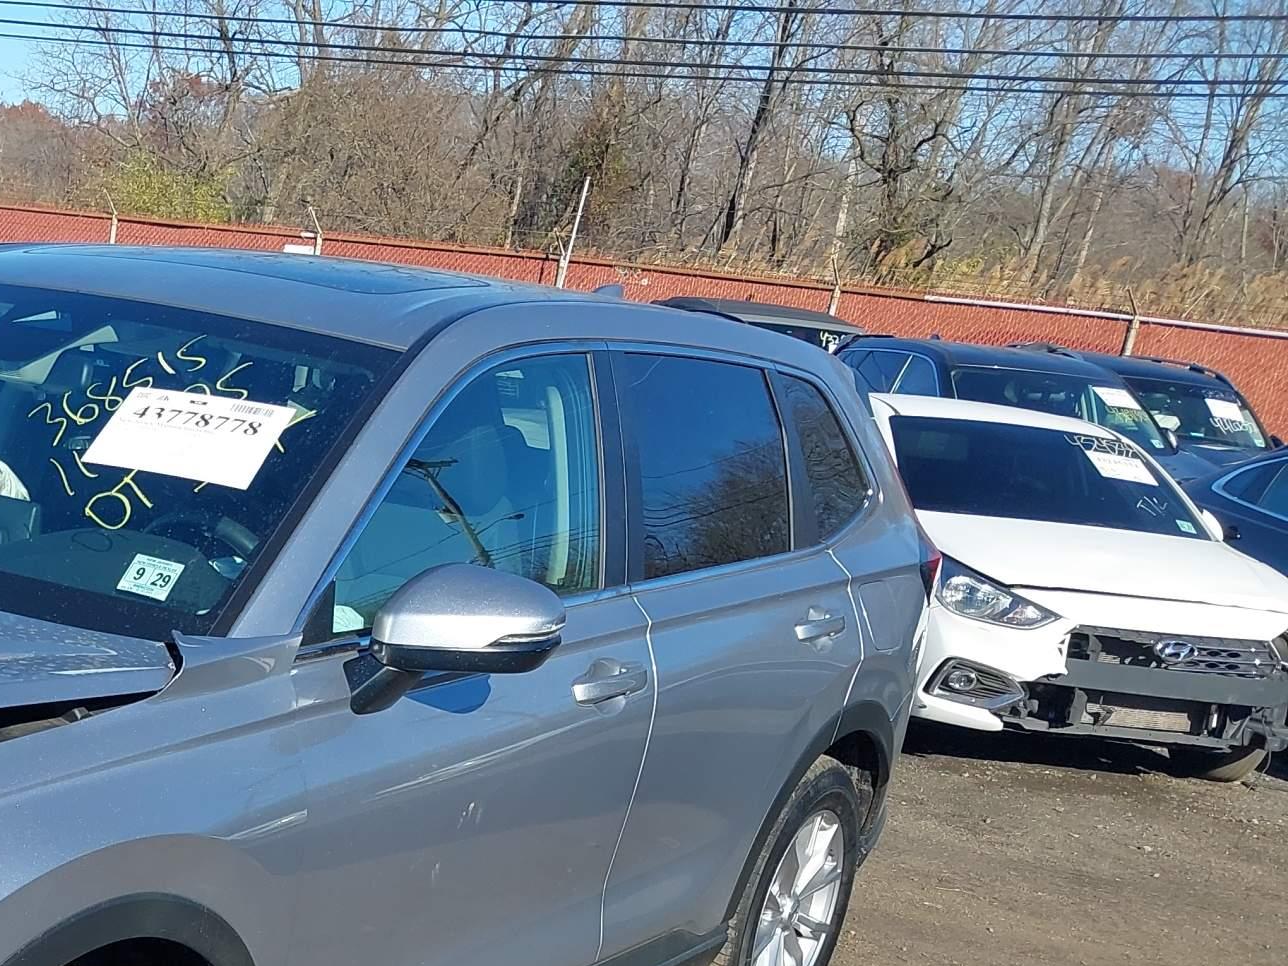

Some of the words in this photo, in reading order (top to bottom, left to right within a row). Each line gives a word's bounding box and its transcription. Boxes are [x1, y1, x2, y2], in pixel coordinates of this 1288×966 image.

[132, 405, 263, 437] 43778778
[133, 567, 146, 581] 9
[150, 572, 172, 588] 29
